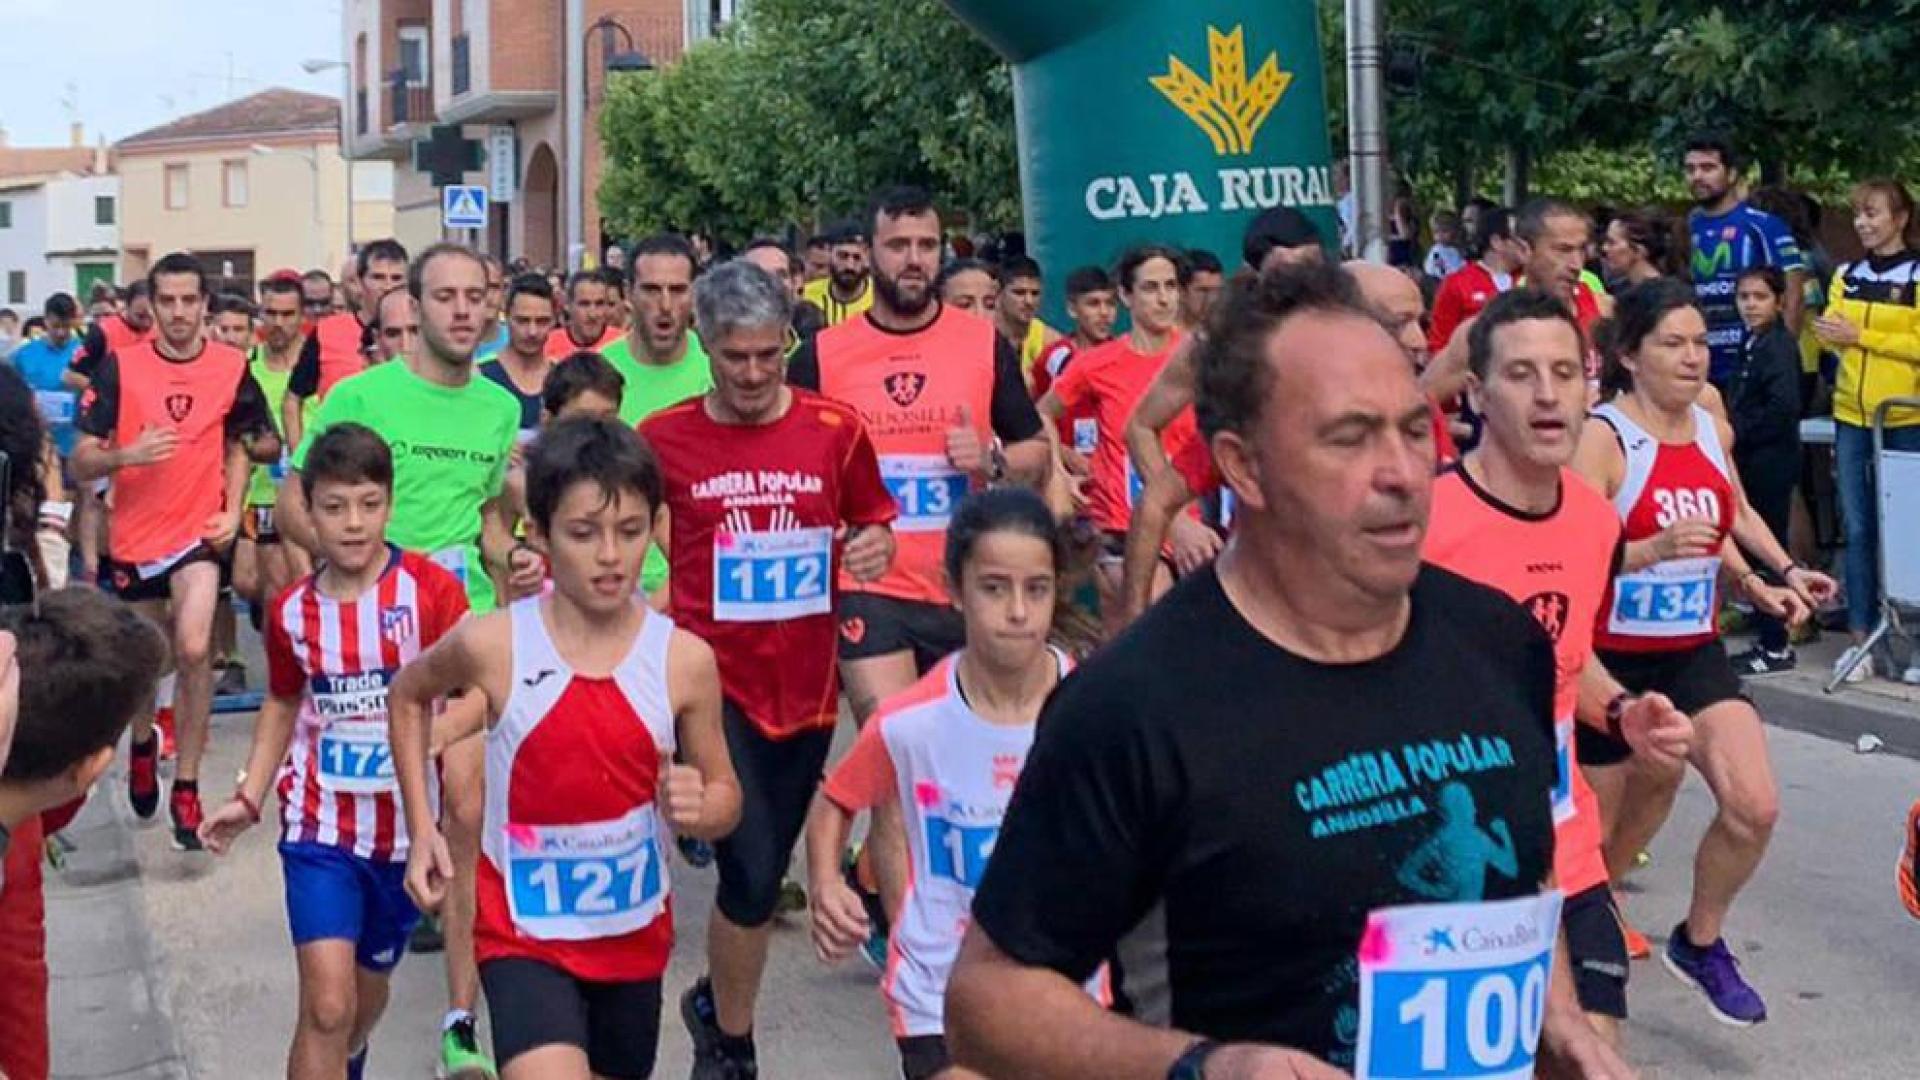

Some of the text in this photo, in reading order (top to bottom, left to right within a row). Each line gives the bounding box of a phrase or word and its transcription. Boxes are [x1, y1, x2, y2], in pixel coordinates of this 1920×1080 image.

[1085, 167, 1335, 219] CAJA RURAL
[691, 470, 824, 498] CARRERA POPULAR
[898, 478, 950, 515] 13
[1653, 487, 1721, 528] 360
[730, 557, 822, 600] 112
[1630, 582, 1708, 620] 134
[330, 671, 383, 693] Trade
[328, 743, 395, 776] 172
[1295, 733, 1515, 813] CARRERA POPULAR
[1311, 796, 1428, 838] ANDOSILLA
[529, 844, 649, 912] 127
[1400, 963, 1546, 1070] 100
